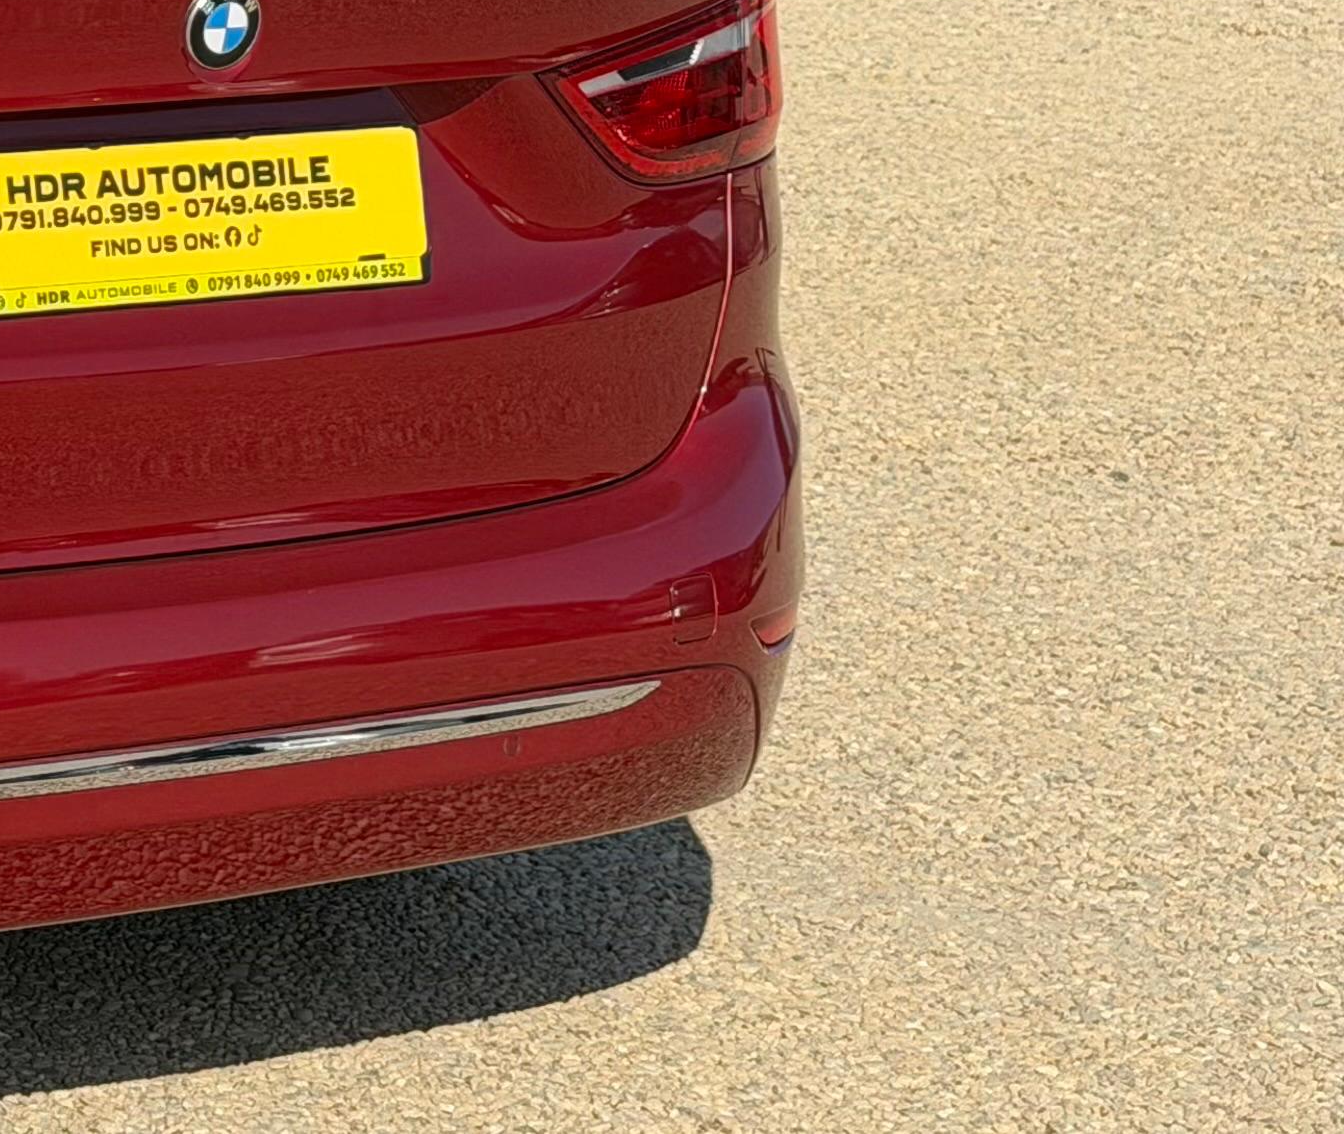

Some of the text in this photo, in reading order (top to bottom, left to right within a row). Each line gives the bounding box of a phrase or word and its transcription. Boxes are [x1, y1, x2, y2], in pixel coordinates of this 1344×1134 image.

[6, 155, 331, 205] HDR AUTOMOBILE
[184, 187, 356, 219] 0749.469.552
[90, 232, 220, 258] FIND US ON:
[36, 281, 177, 306] HDR AUTOMOBILE
